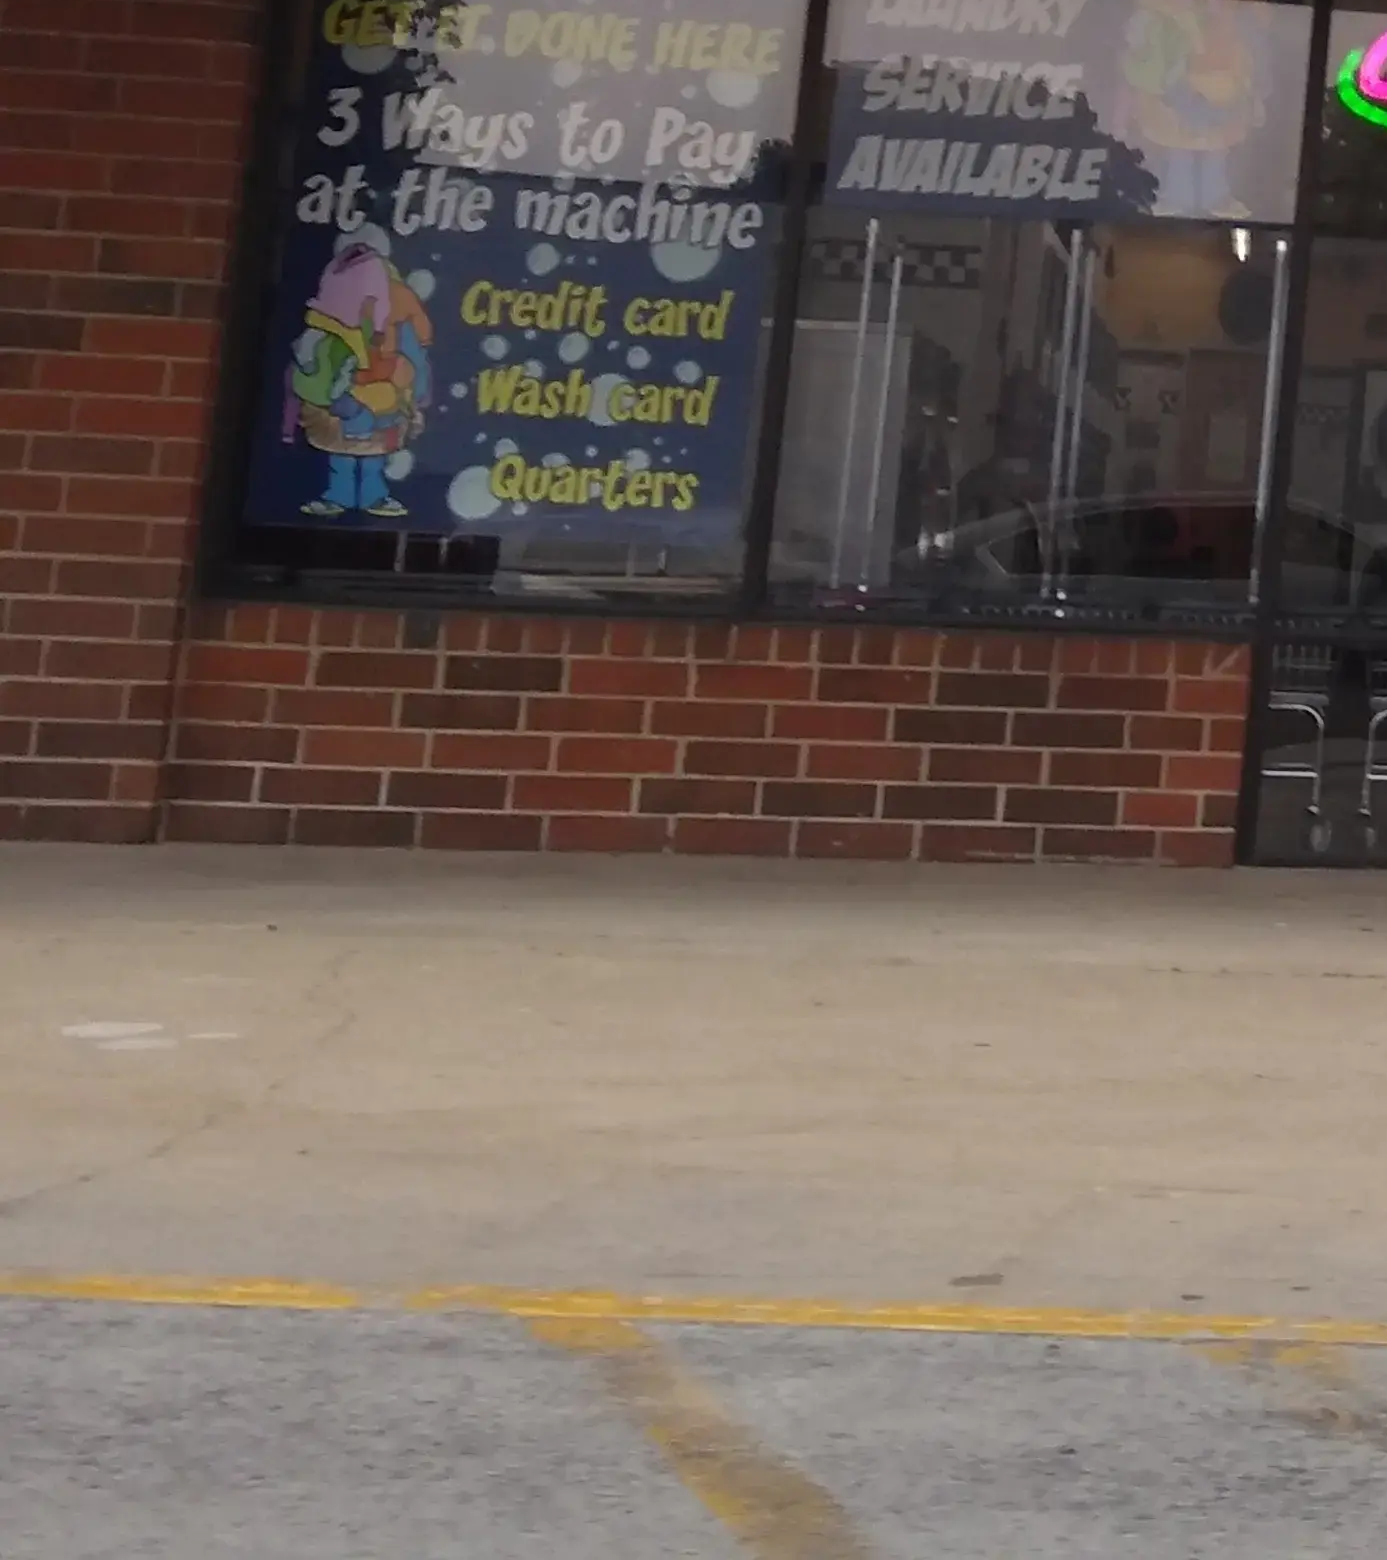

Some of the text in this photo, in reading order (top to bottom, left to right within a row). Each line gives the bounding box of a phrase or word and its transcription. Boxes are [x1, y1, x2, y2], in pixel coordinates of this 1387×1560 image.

[505, 9, 641, 73] DONE
[655, 19, 785, 75] HERE
[861, 52, 1084, 122] SERVICE
[318, 87, 756, 189] 3 Ways to Pay
[836, 135, 1110, 200] AVAILABLE
[296, 164, 764, 251] at the machine
[461, 280, 734, 341] Credit card
[475, 366, 718, 427] Wash card
[490, 453, 699, 511] Quarters
